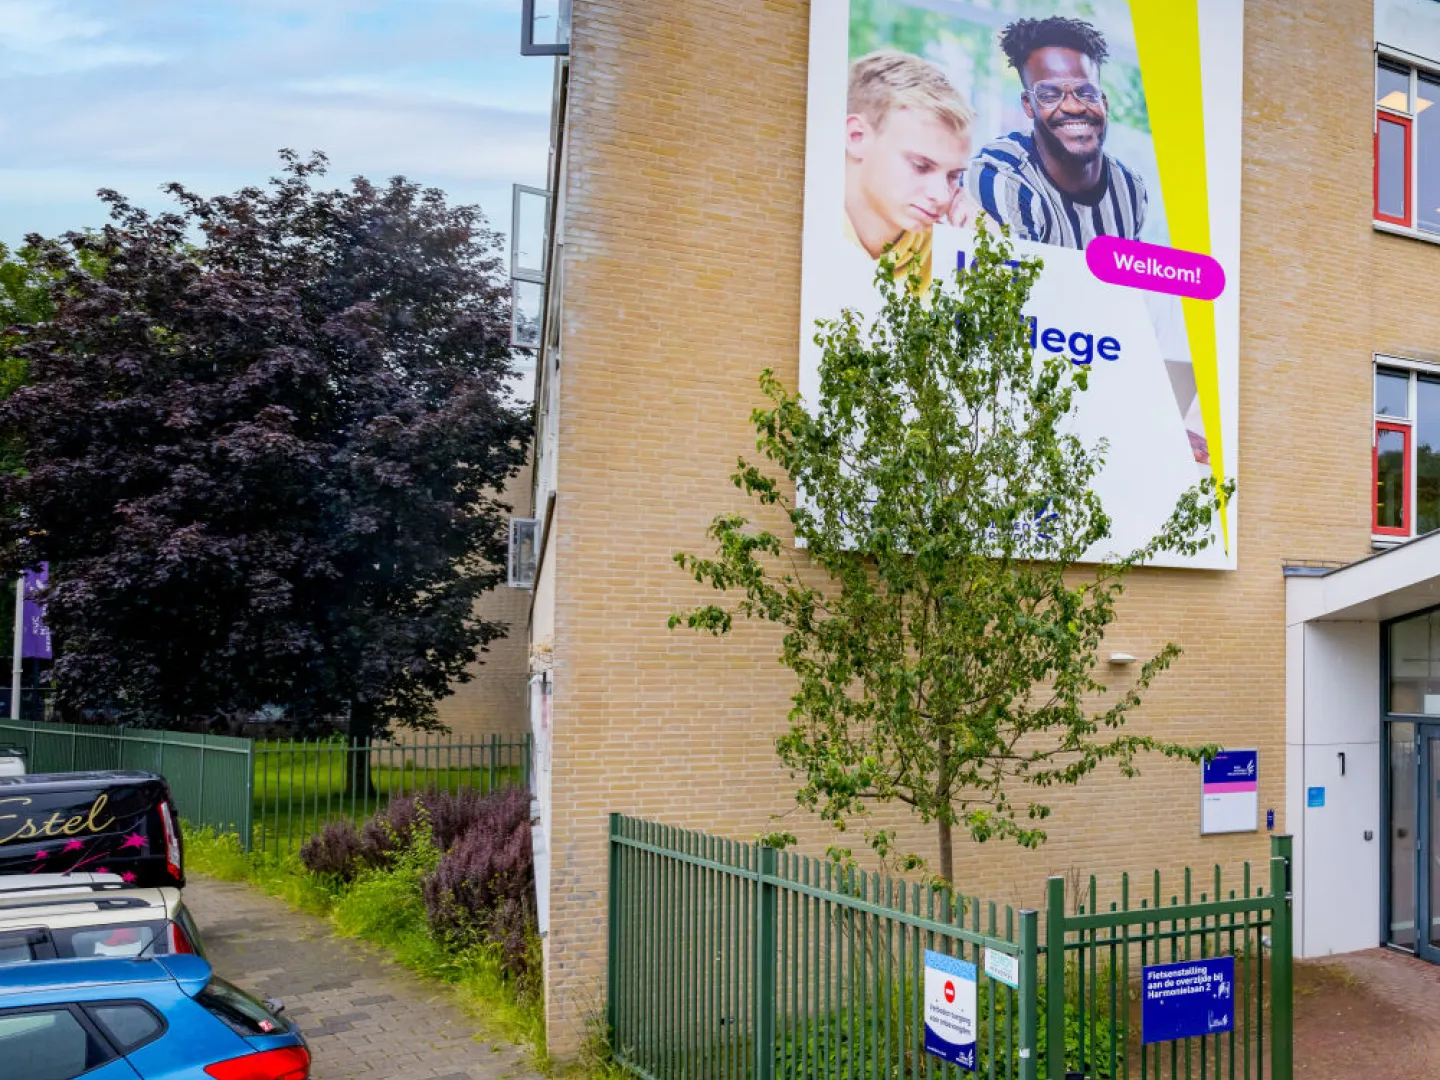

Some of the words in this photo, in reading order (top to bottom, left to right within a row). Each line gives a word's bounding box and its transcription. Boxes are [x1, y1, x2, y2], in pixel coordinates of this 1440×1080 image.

[1112, 250, 1203, 284] Welkom!
[1337, 752, 1346, 776] 1
[1147, 966, 1208, 981] Fietsenstalling
[1147, 981, 1163, 990] aan
[1164, 979, 1175, 988] de
[1176, 974, 1212, 985] overzijde
[1213, 972, 1224, 982] bij
[1147, 985, 1205, 999] Harmonielaan
[1206, 982, 1212, 991] 2
